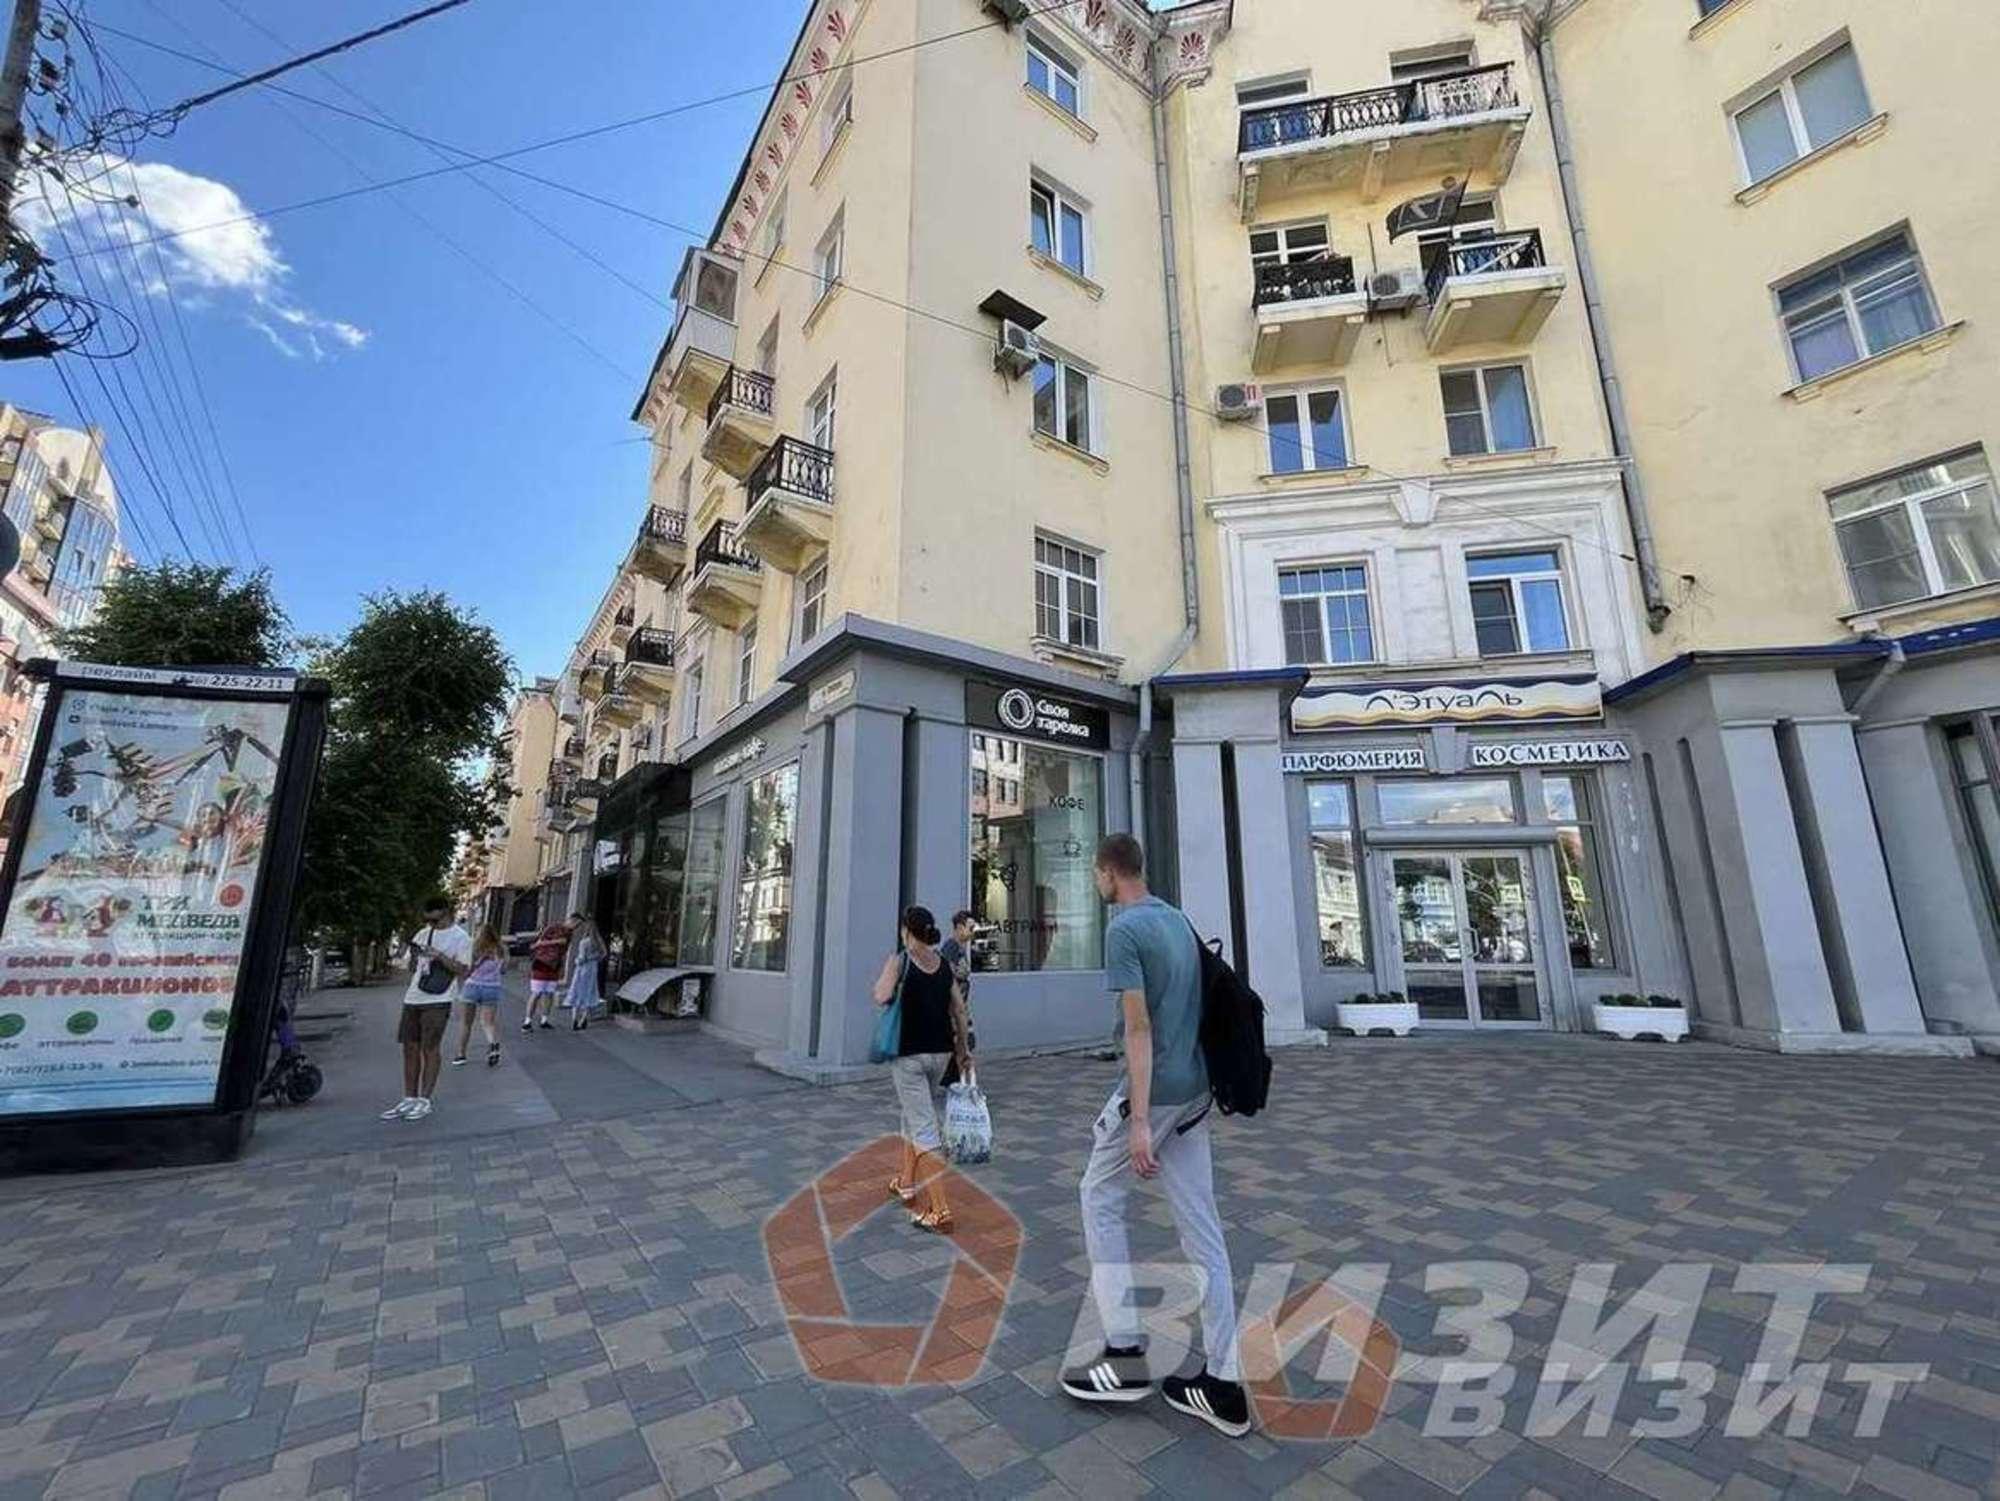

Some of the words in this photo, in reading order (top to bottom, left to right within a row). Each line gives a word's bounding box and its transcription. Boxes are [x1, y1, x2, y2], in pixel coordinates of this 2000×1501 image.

[211, 674, 283, 689] 225-22-11
[1035, 699, 1070, 719] Своя
[1035, 717, 1090, 738] тарелка
[1283, 751, 1423, 770] ПАРФЮМЕРИЯ
[1475, 743, 1627, 763] КОСМЕТИКА
[1048, 794, 1086, 811] КОФЕ
